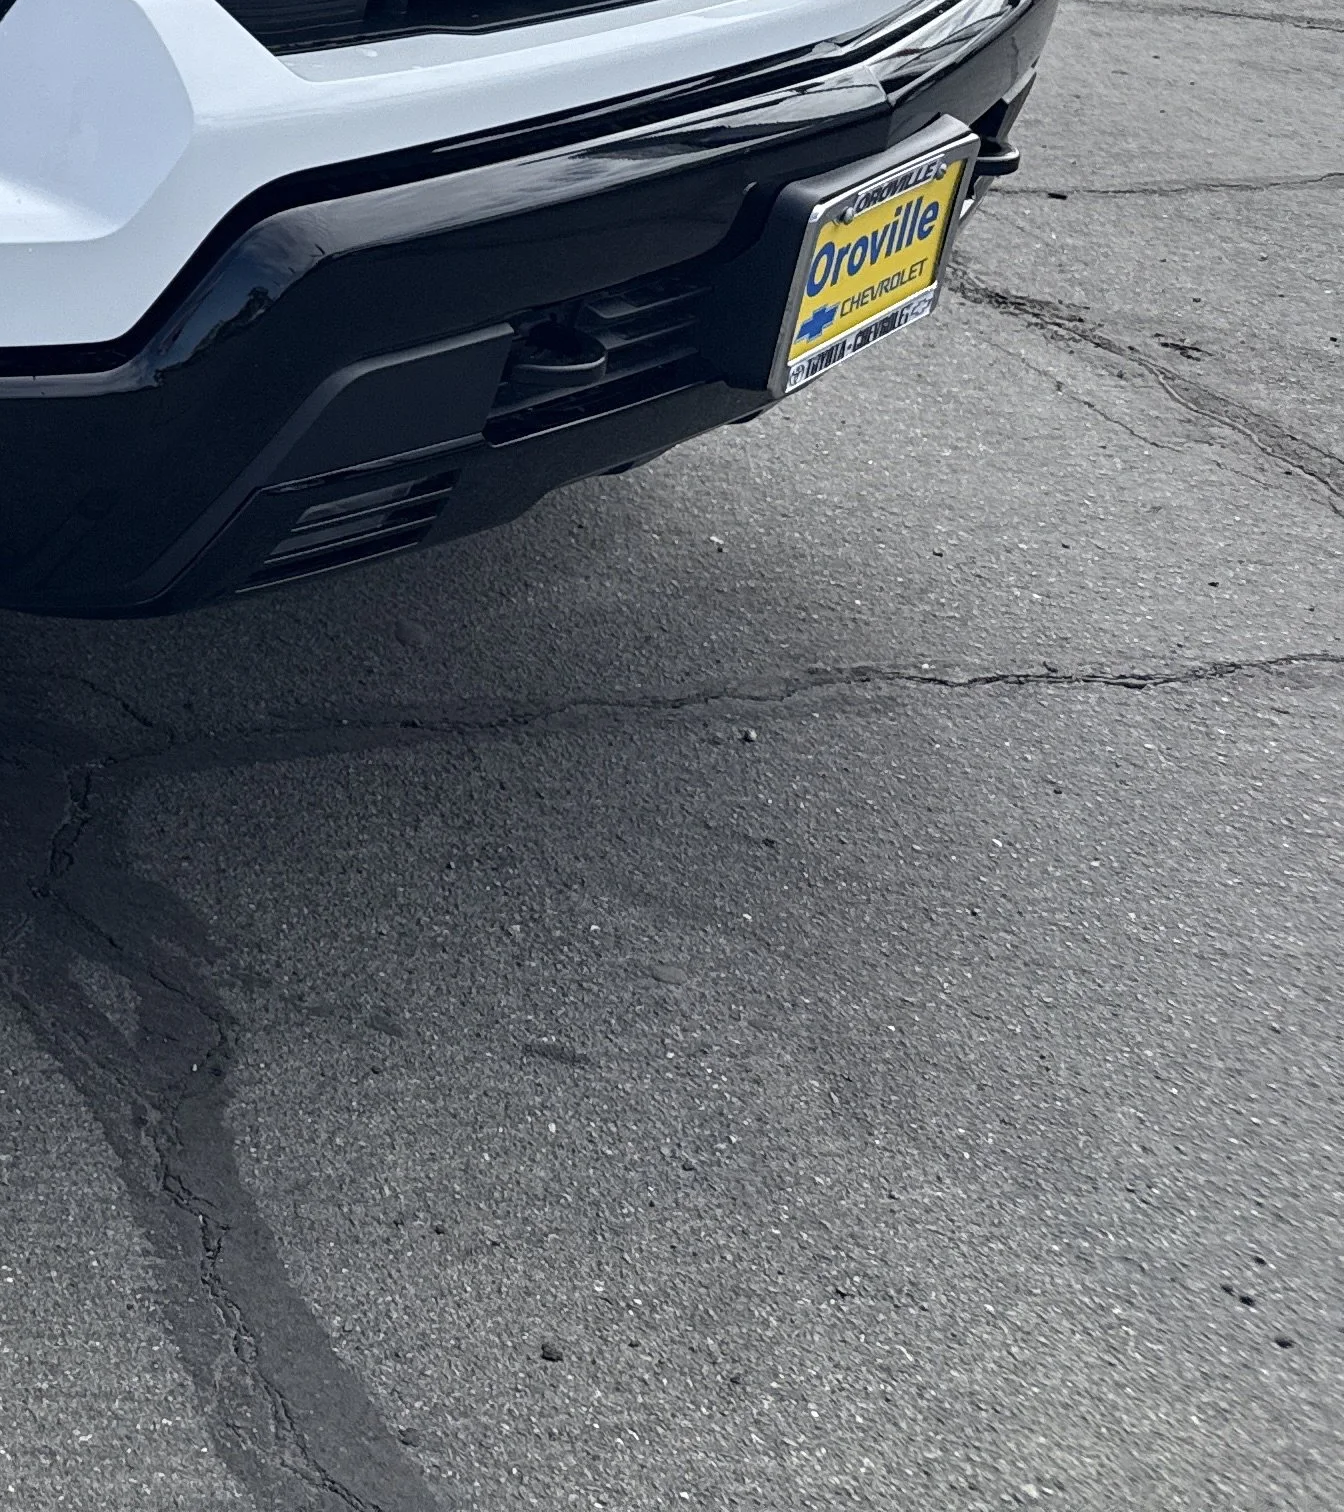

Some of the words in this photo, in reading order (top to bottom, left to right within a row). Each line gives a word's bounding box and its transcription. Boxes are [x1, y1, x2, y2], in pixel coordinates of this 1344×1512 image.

[854, 160, 939, 213] OROVILLE
[806, 195, 940, 297] Oroville
[839, 257, 928, 318] CHEVROLET
